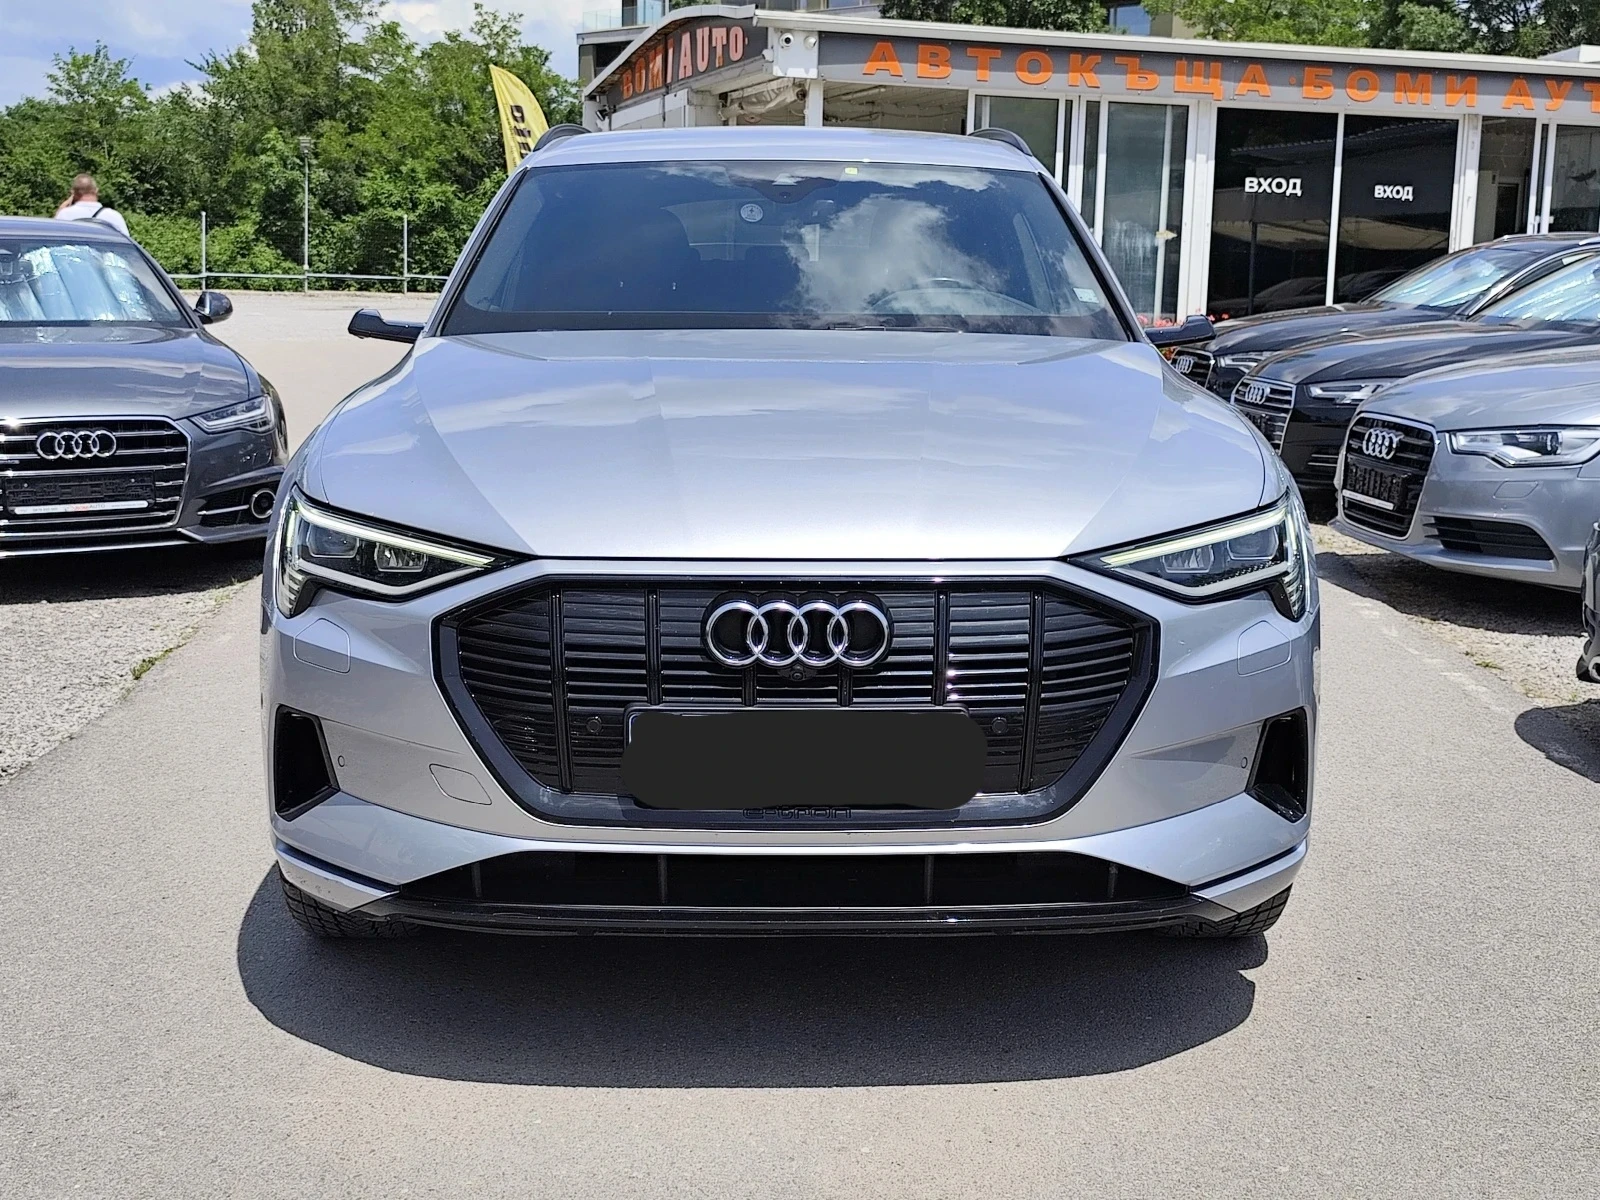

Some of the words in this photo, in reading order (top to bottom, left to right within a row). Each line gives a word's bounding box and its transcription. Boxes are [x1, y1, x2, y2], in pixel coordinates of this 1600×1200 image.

[621, 38, 675, 100] BOMI
[678, 25, 744, 80] AUTO
[862, 41, 1272, 101] АВТОКЪЩА
[1301, 66, 1479, 108] БОМИ
[1244, 176, 1303, 198] ВХОД
[1374, 183, 1414, 202] ВХОД
